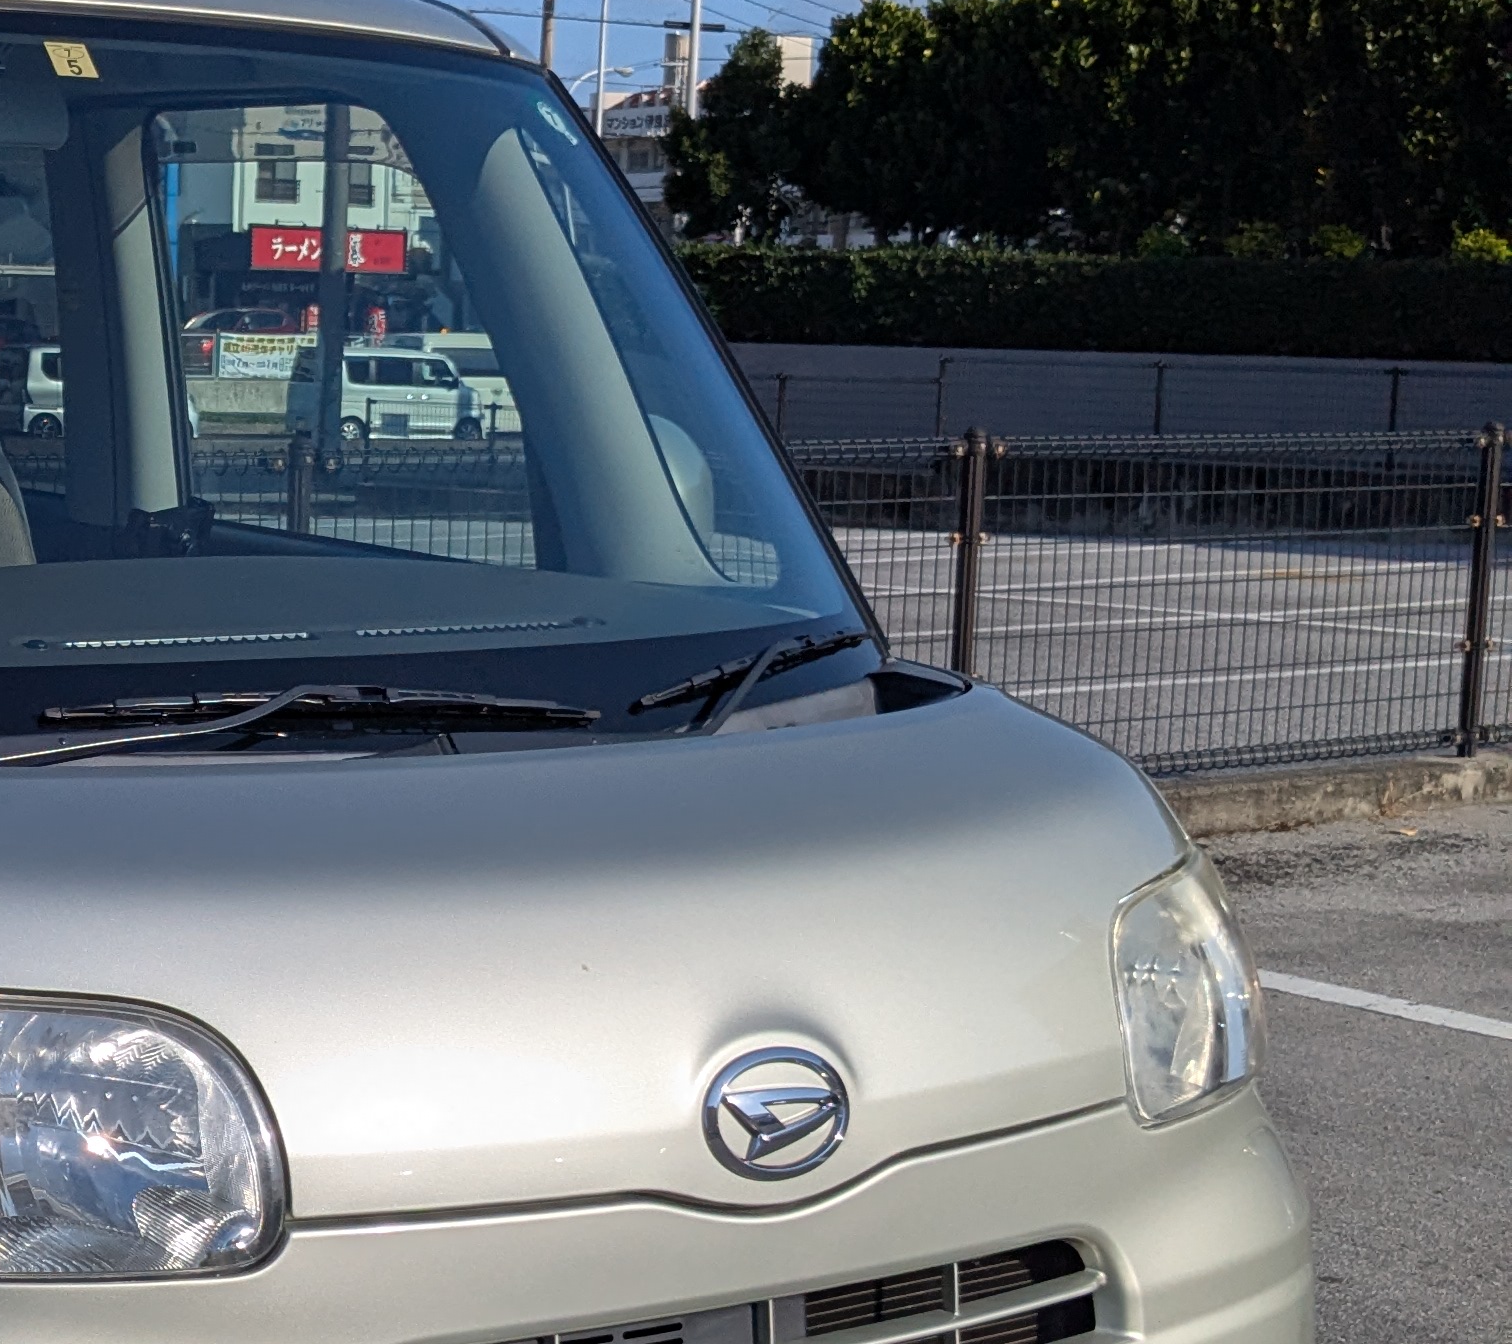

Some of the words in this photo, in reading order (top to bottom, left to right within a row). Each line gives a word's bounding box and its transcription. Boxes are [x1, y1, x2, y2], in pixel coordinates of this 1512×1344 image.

[66, 59, 83, 76] 5
[271, 237, 321, 261] ラーメン
